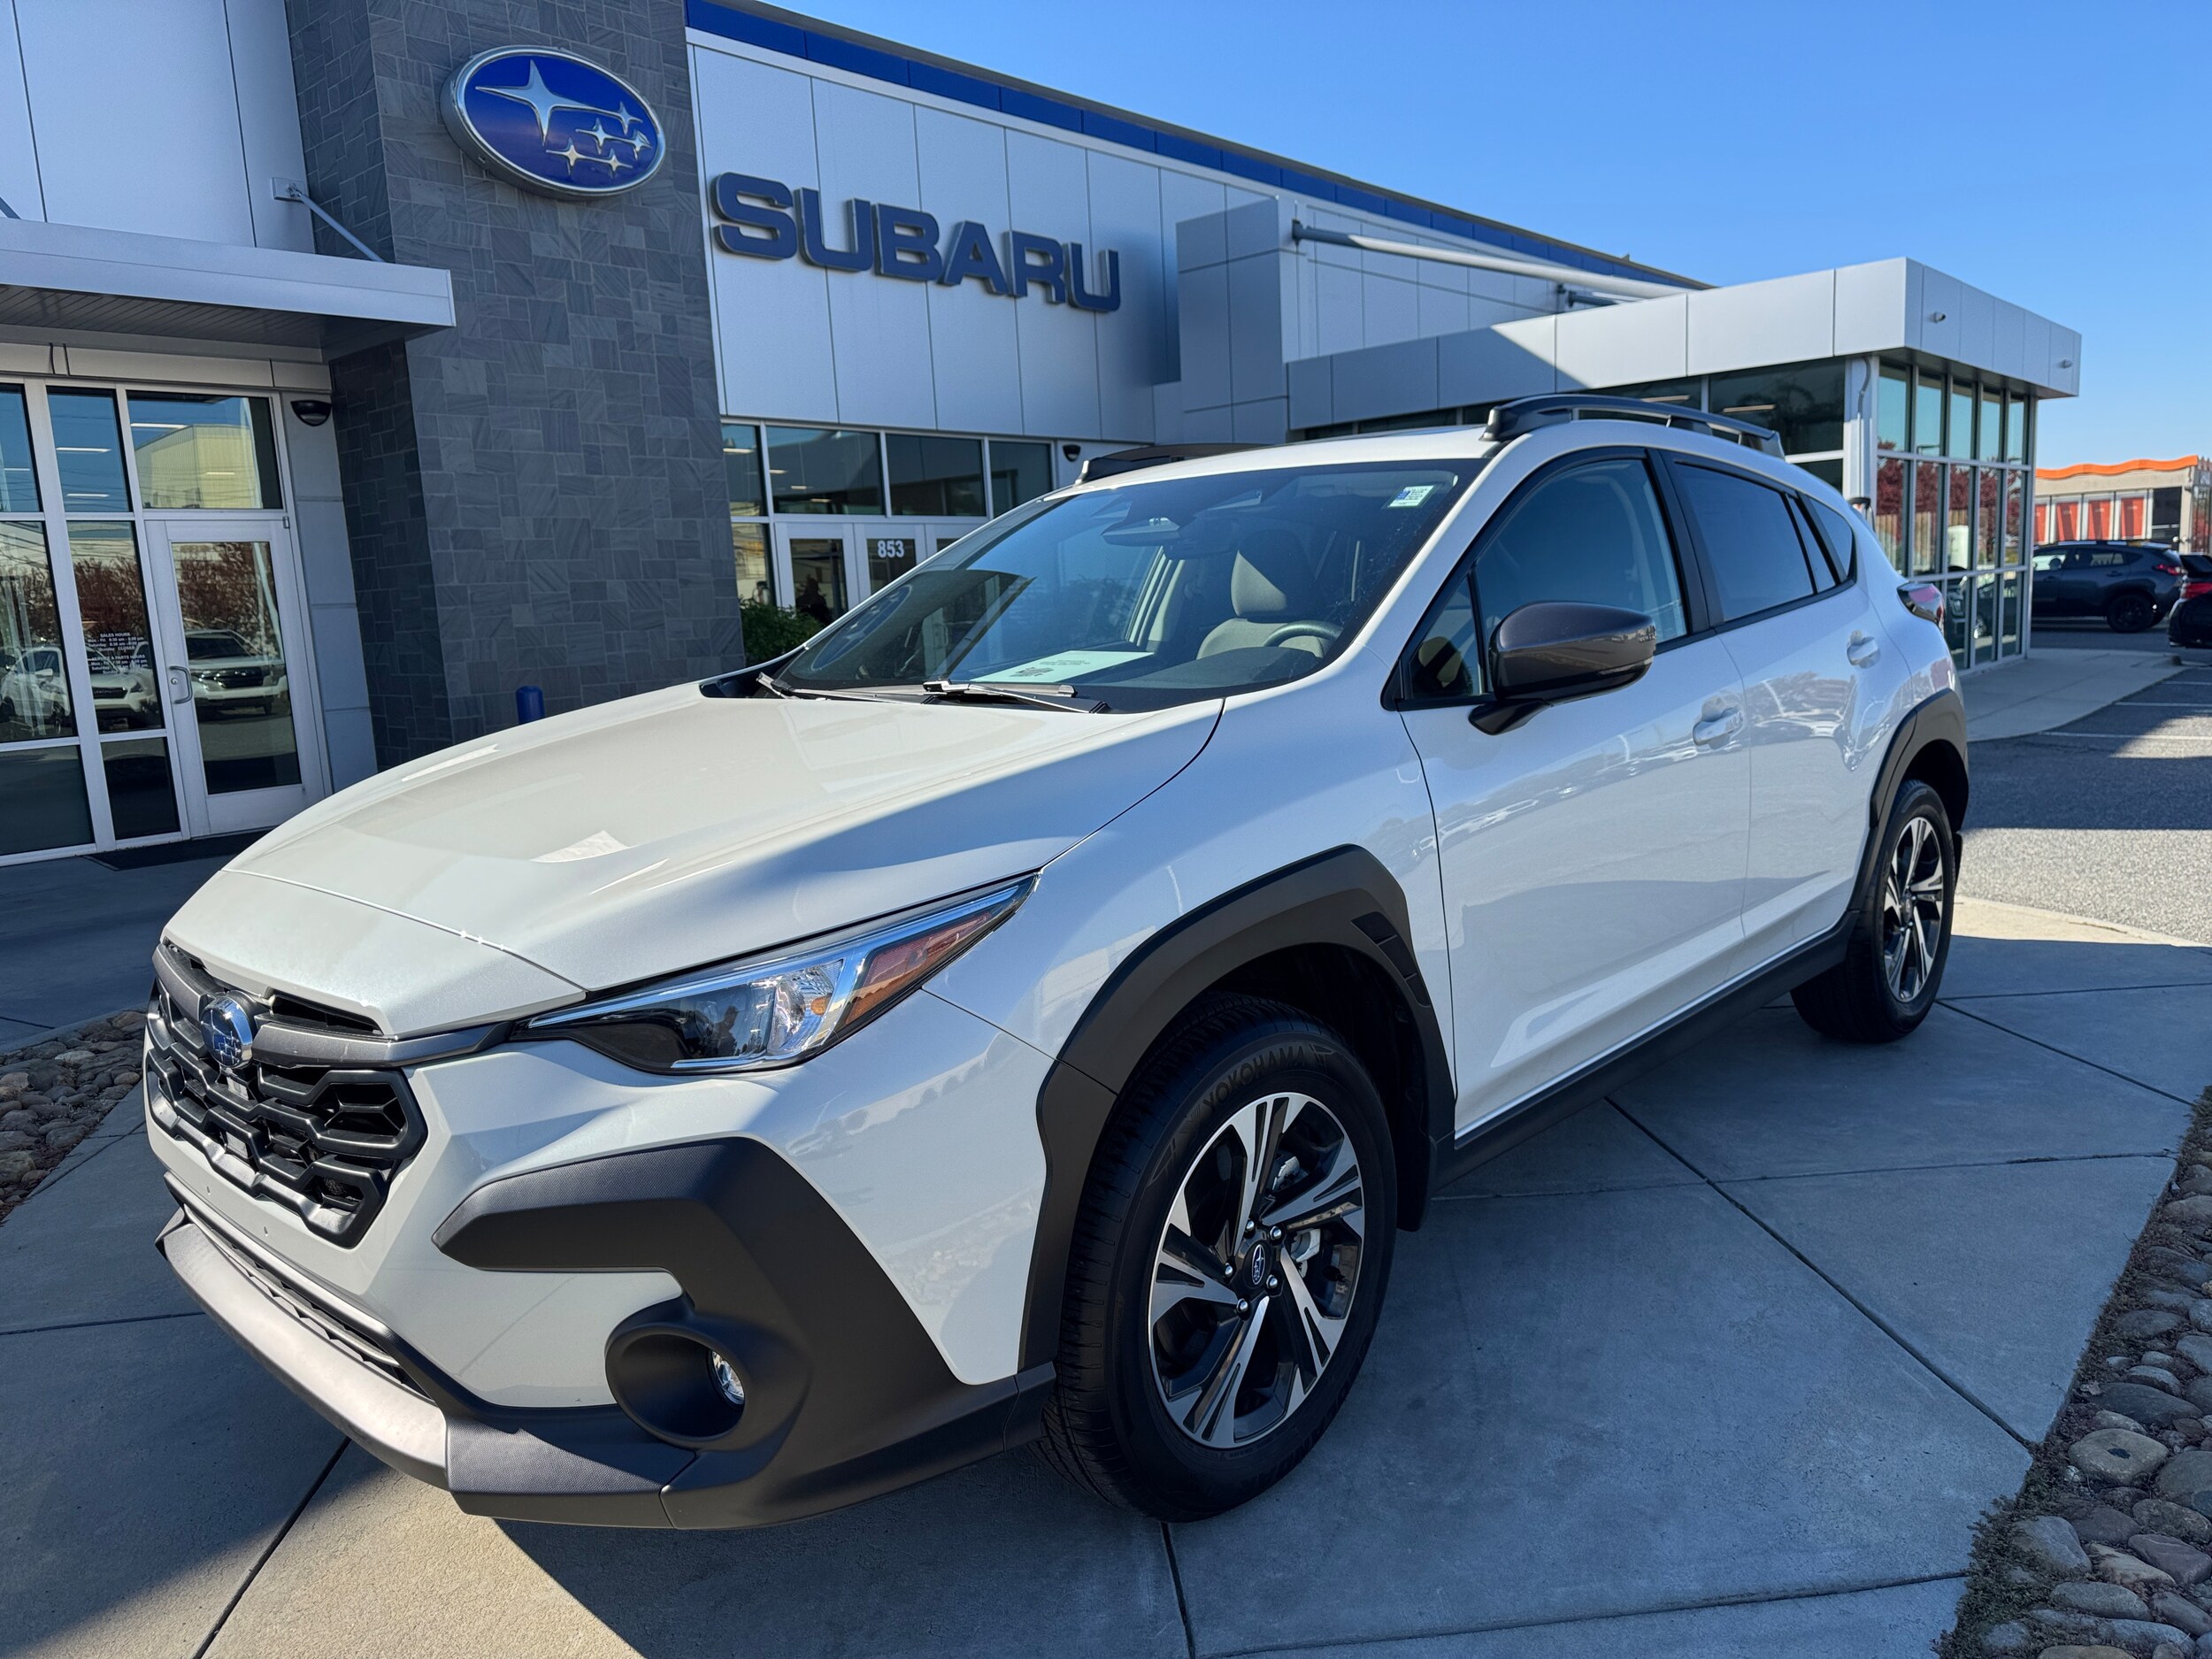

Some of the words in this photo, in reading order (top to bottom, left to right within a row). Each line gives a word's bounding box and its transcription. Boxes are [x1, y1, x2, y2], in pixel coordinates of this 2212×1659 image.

[710, 173, 1120, 311] SUBARU
[878, 540, 904, 557] 853
[1202, 1045, 1306, 1110] YOKOHAMA
